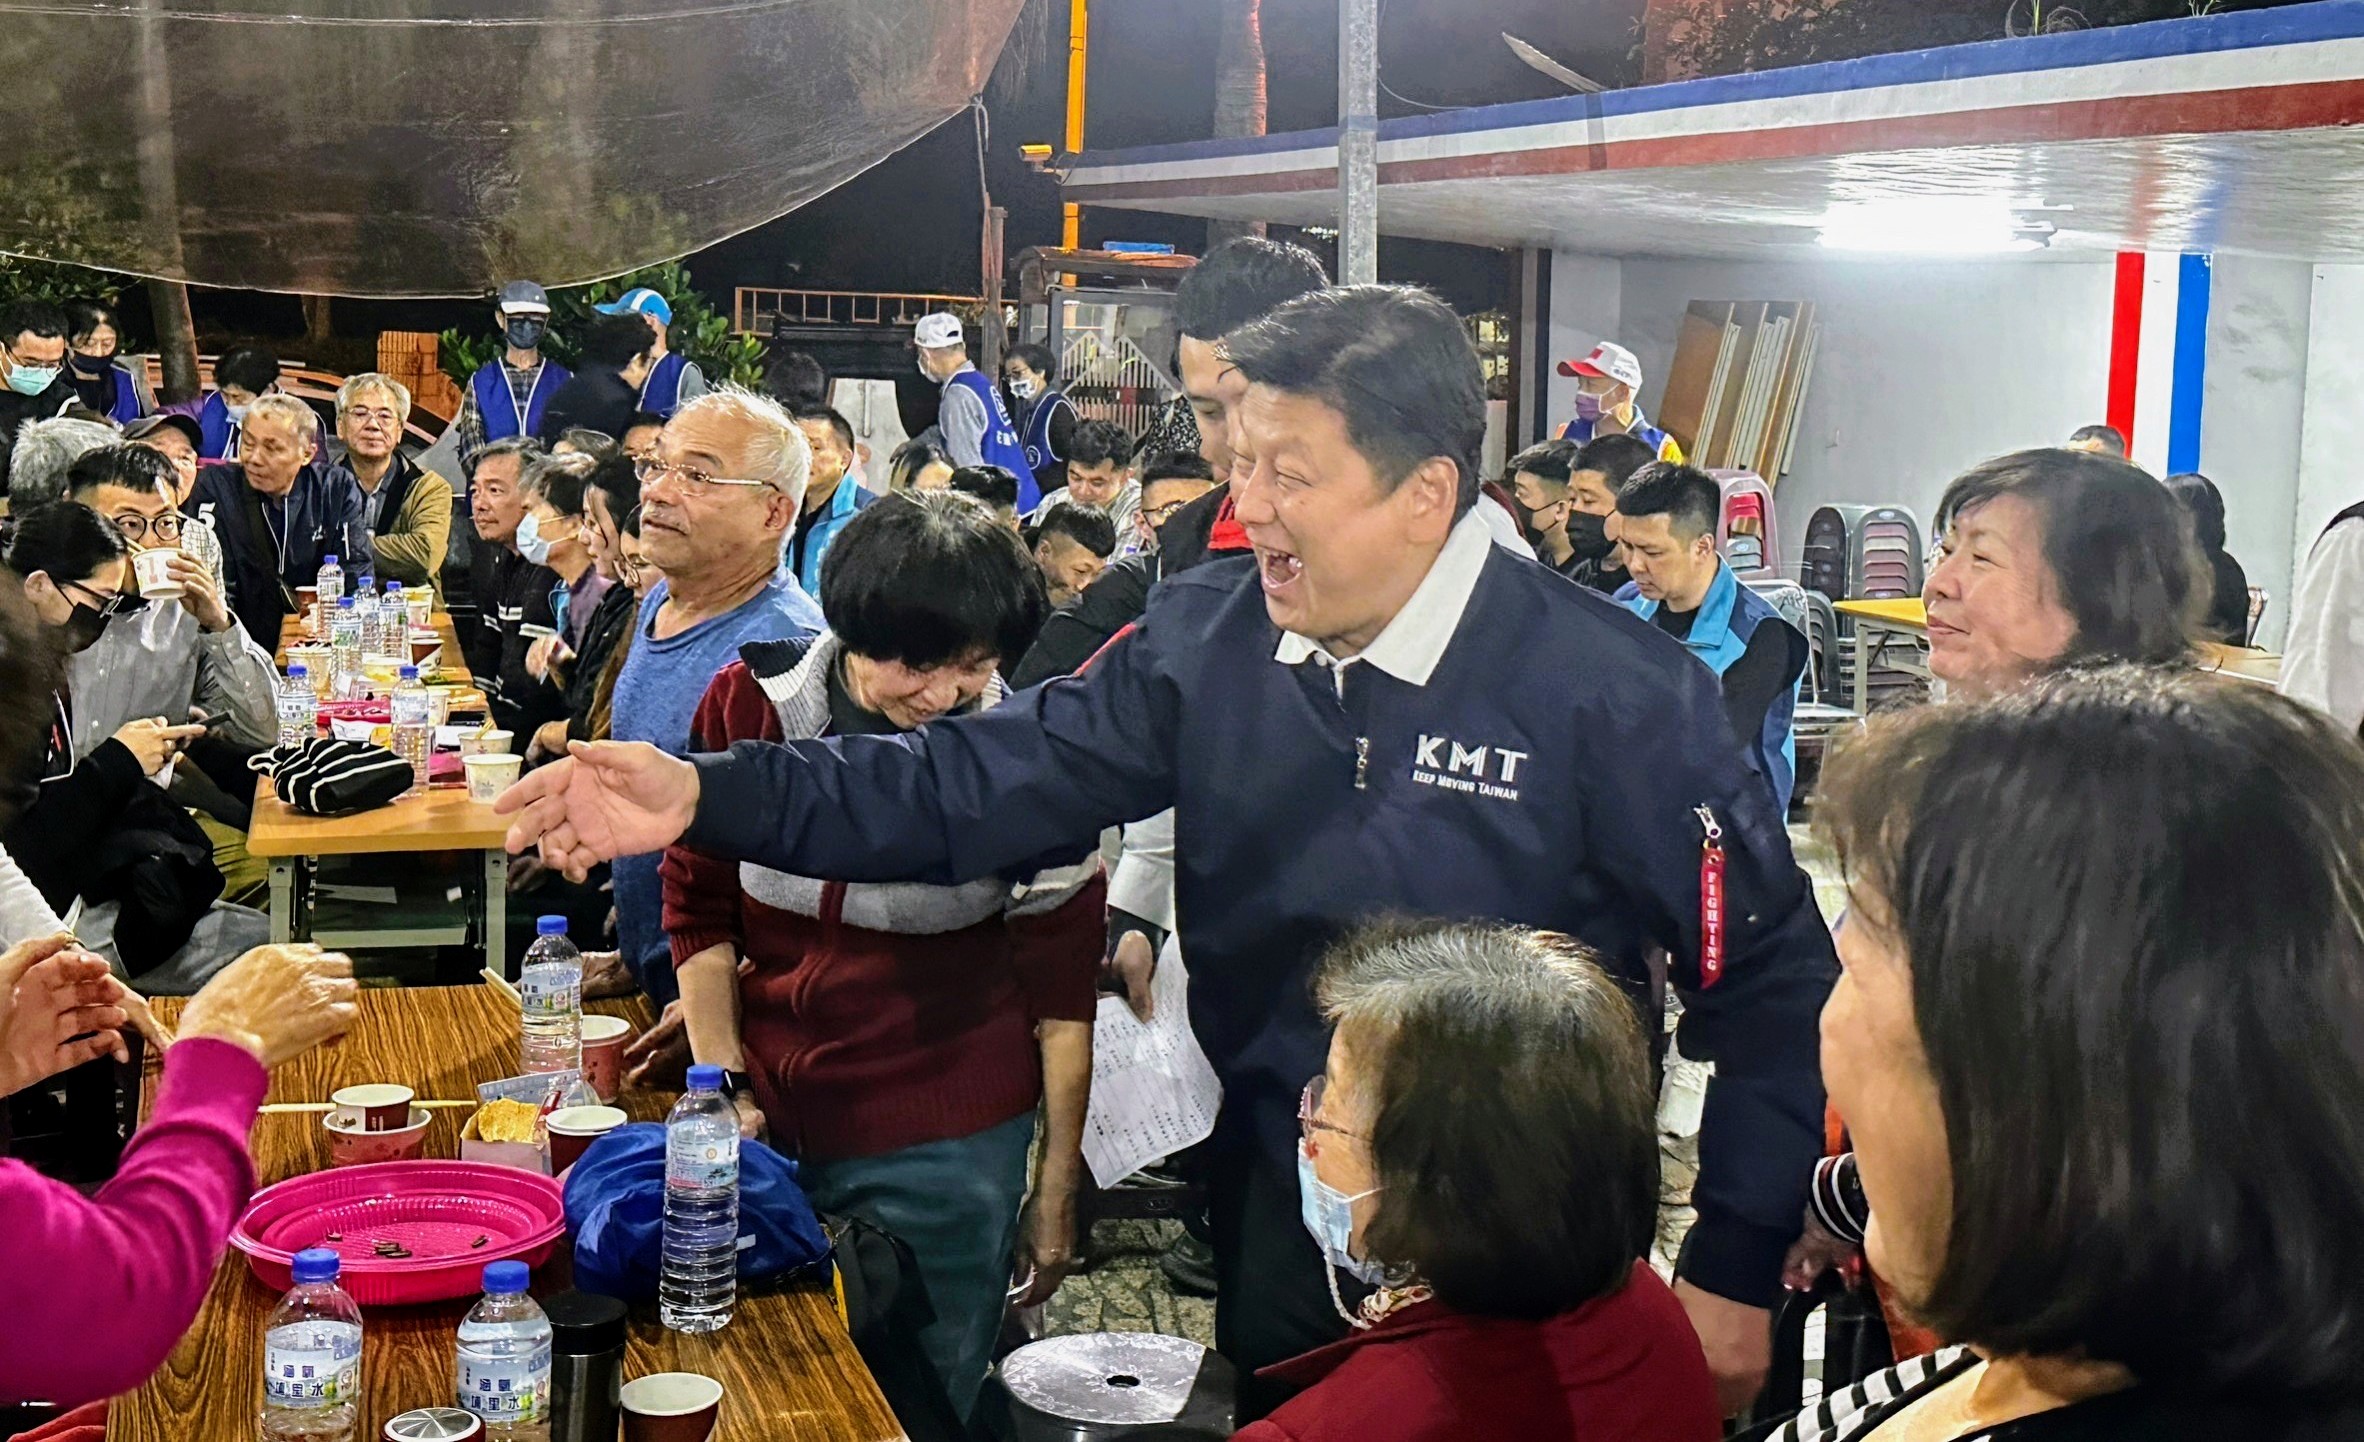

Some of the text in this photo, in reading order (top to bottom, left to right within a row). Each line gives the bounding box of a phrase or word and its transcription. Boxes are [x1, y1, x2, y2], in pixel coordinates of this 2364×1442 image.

[1415, 734, 1528, 782] KMT
[1412, 770, 1518, 801] KEEP MOVING TAIWAN
[1706, 871, 1719, 971] FIGHTING
